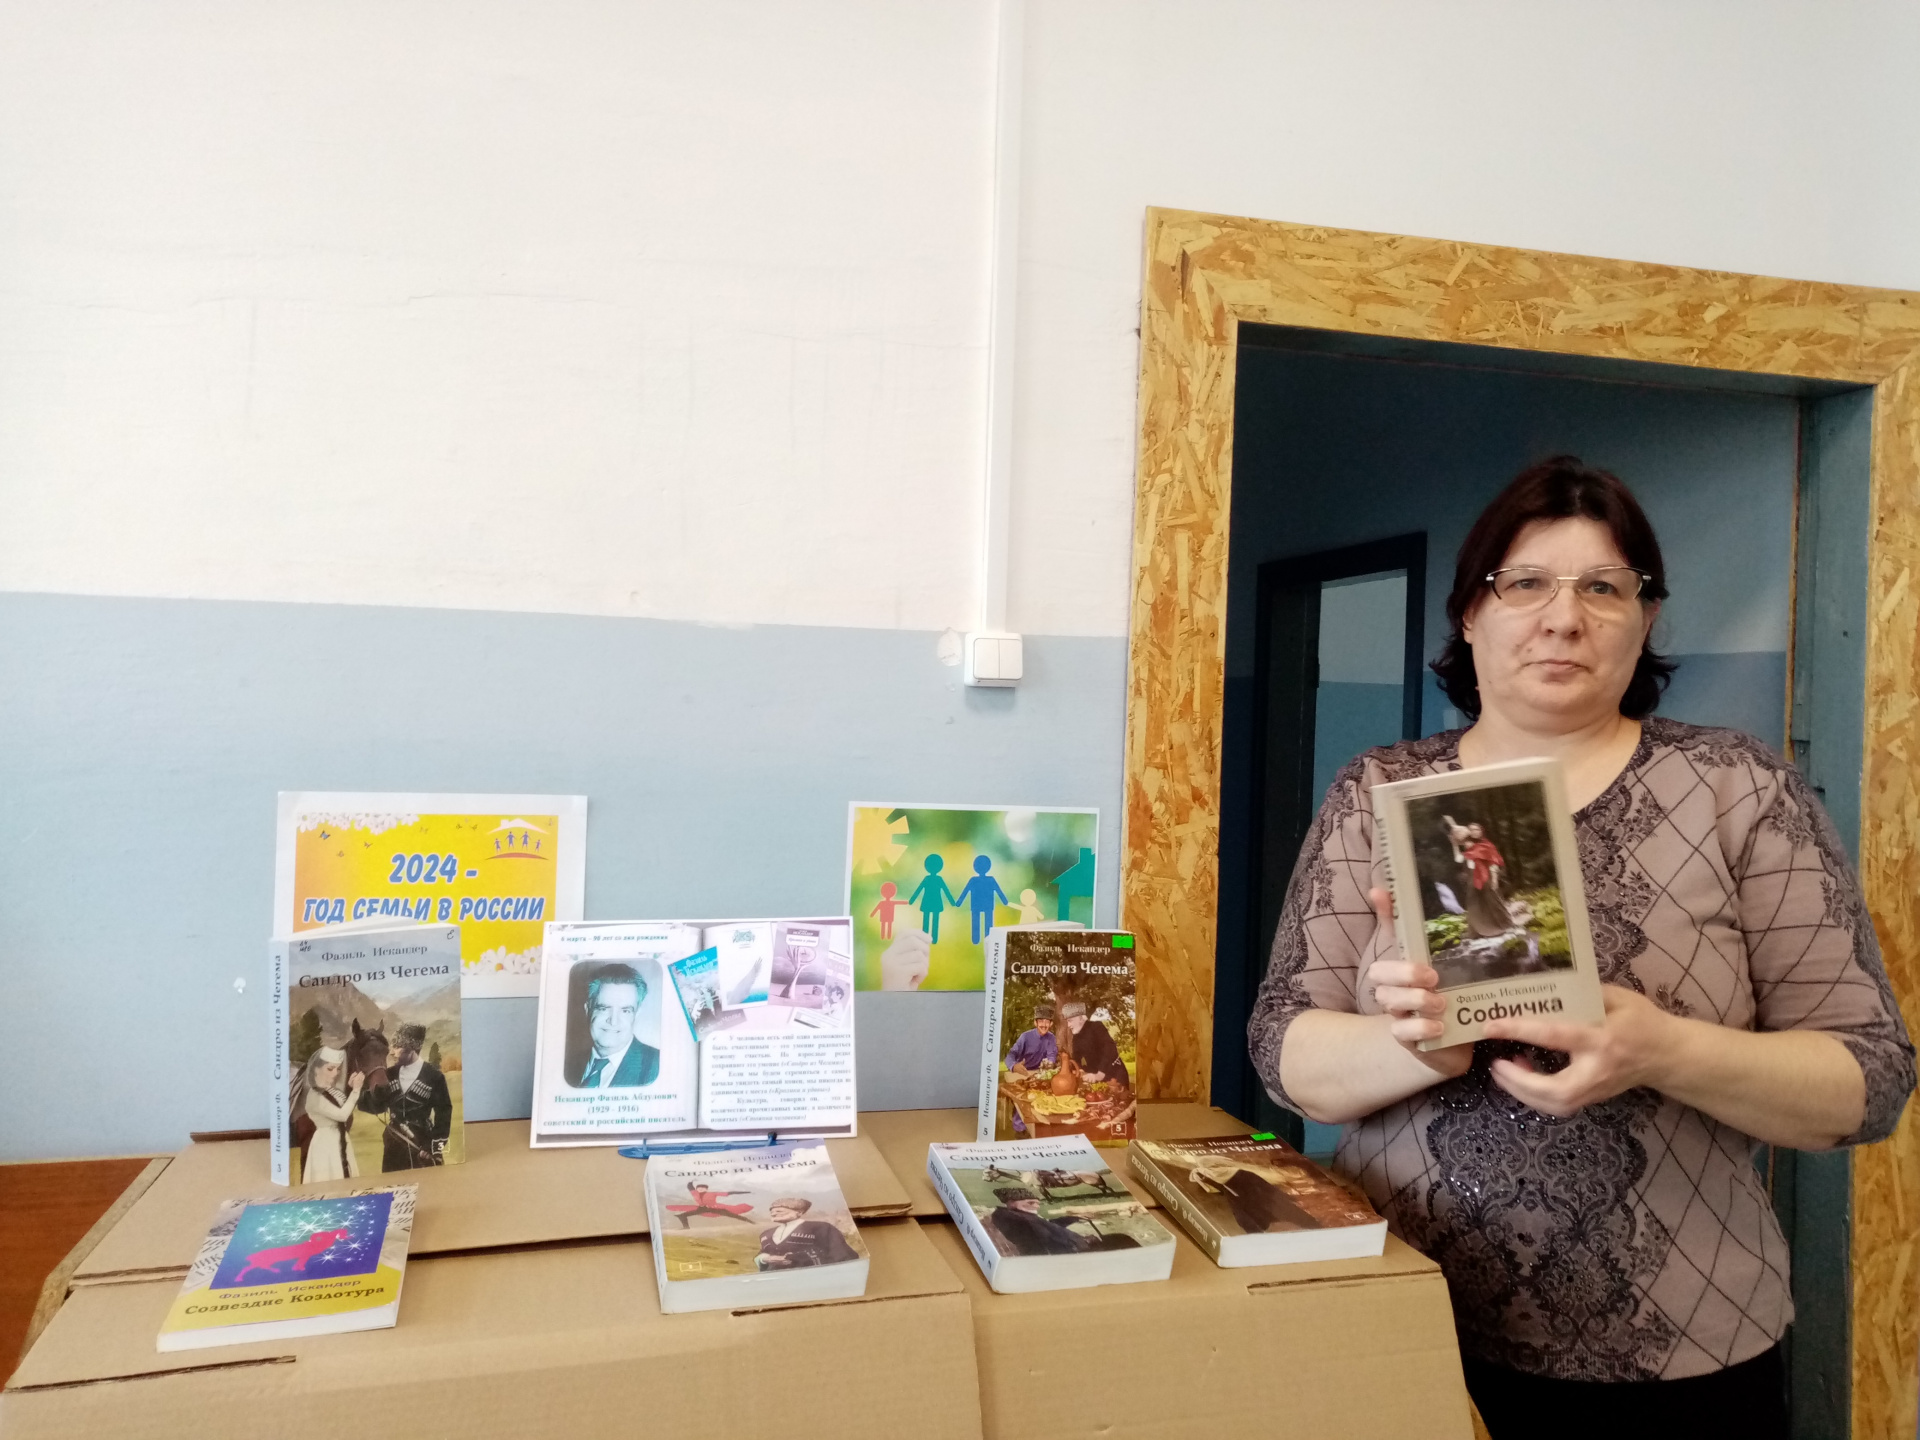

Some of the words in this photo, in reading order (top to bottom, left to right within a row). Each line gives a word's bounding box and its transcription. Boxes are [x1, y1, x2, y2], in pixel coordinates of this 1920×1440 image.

[389, 854, 457, 883] 2024
[303, 898, 345, 923] ГОД
[353, 897, 431, 921] СЕМЬИ
[438, 898, 451, 921] В
[459, 897, 545, 921] РОССИИ
[321, 952, 366, 962] Фазиль
[373, 946, 428, 957] Искандер
[1029, 943, 1063, 953] Фазиль
[1067, 943, 1111, 956] Искандер
[990, 942, 1000, 986] Чегема
[1010, 961, 1058, 977] Сандро
[1062, 965, 1077, 974] из
[1079, 961, 1128, 975] Чегема
[273, 955, 282, 1004] Чегема
[299, 973, 362, 988] Сандро
[367, 970, 386, 982] из
[390, 964, 449, 979] Чегема
[990, 989, 997, 1004] из
[1455, 992, 1497, 1005] Фазиль
[1499, 983, 1557, 998] Искандер
[274, 1009, 281, 1023] из
[1456, 997, 1564, 1026] Софичка
[986, 1006, 998, 1053] Сандро
[273, 1027, 284, 1080] Сандро
[554, 1095, 595, 1104] Искандер
[597, 1094, 629, 1102] Фазиль
[983, 1077, 993, 1118] Искандер
[587, 1105, 610, 1114] (1929
[543, 1118, 587, 1127] советский
[597, 1116, 646, 1127] российский
[648, 1116, 686, 1124] писатель
[1116, 1124, 1122, 1132] 5
[983, 1127, 989, 1136] 5
[438, 1142, 445, 1152] 3
[949, 1154, 1008, 1163] Сандро
[1032, 1148, 1088, 1159] Чегема
[1230, 1143, 1282, 1153] Чегема
[664, 1168, 729, 1178] Сандро
[757, 1160, 818, 1172] Чегема
[1157, 1182, 1178, 1211] Сандро
[218, 1289, 278, 1300] Фазиль
[288, 1280, 361, 1293] Искандер
[185, 1298, 284, 1315] Созвездие
[289, 1286, 385, 1304] Козлотура
